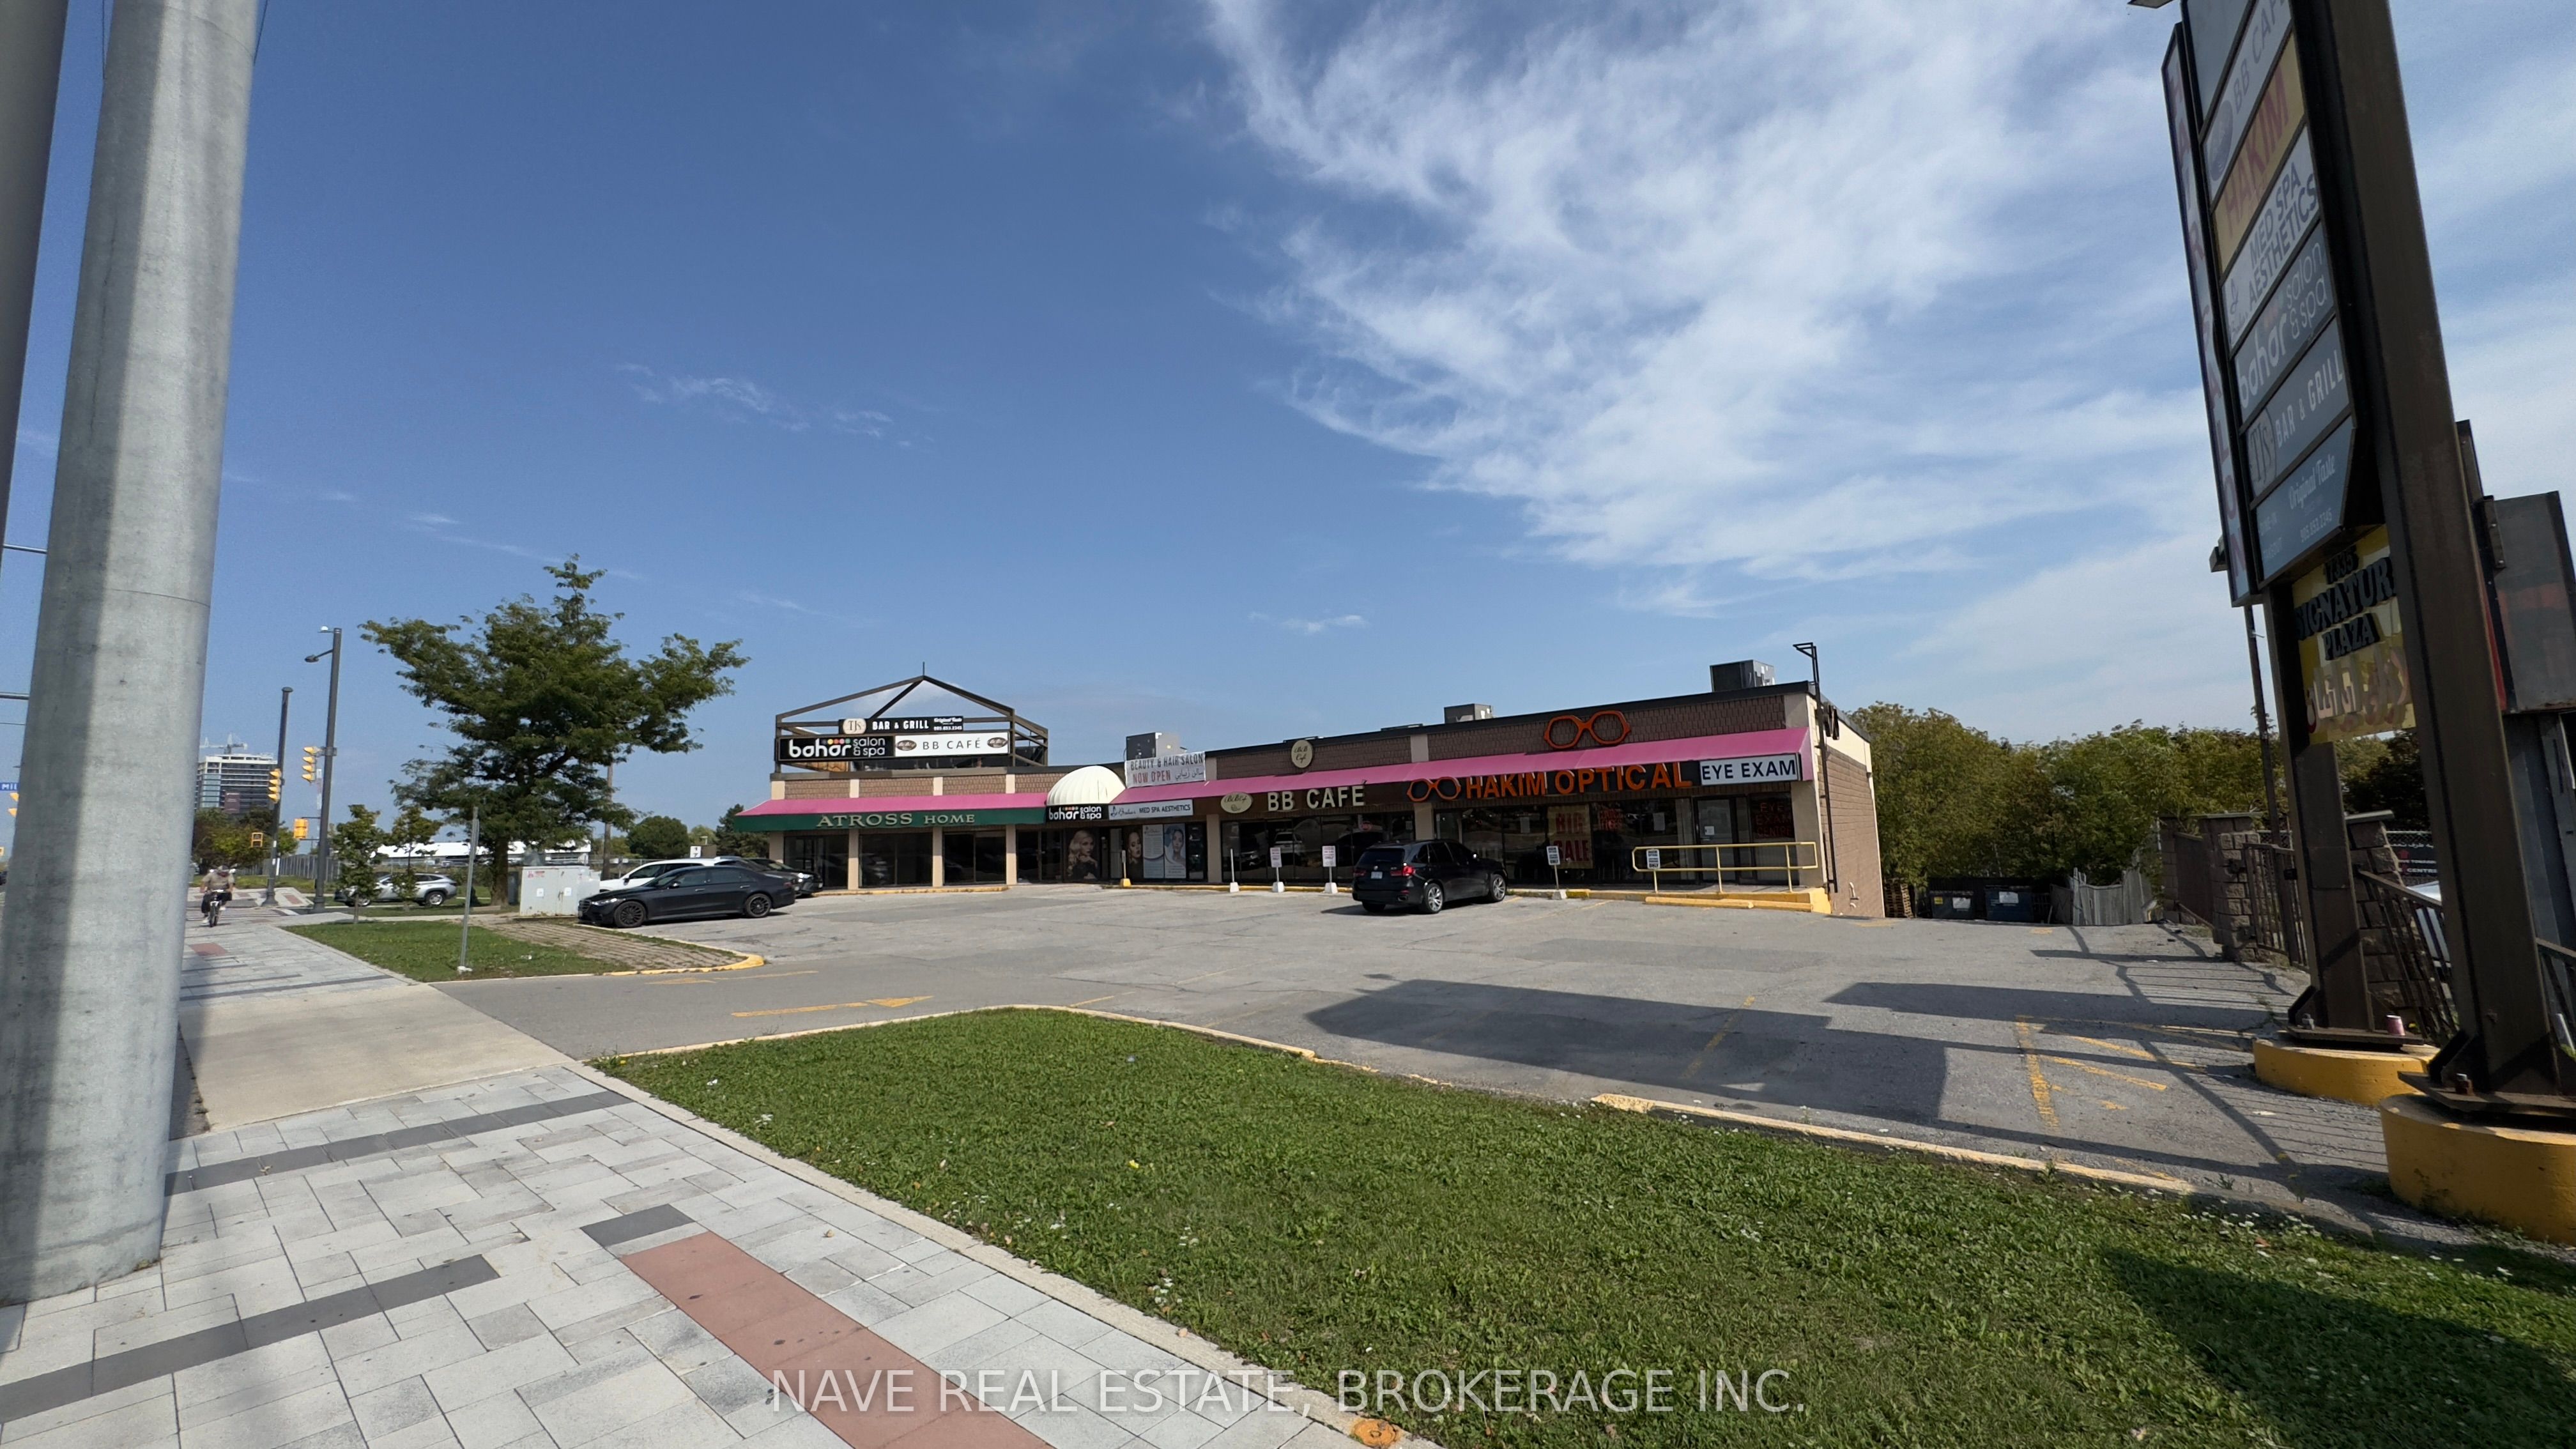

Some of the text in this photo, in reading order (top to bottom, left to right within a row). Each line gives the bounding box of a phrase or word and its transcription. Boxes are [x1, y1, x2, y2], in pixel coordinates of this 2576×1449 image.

[2233, 0, 2285, 114] BB CAF
[2225, 62, 2288, 236] HAKIM
[2250, 208, 2274, 270] MED
[2276, 162, 2301, 222] SPA
[2248, 172, 2317, 312] AESTHETICS
[2287, 242, 2322, 309] salon
[2300, 274, 2327, 328] spa
[2237, 312, 2287, 409] bahar
[2276, 404, 2296, 448] BAR
[2299, 398, 2306, 421] &
[2307, 349, 2343, 411] GRILL
[2294, 557, 2396, 640] SIGNATUR
[2322, 614, 2377, 660] PLAZA
[872, 721, 890, 730] BAR
[903, 720, 929, 729] GRILL
[789, 738, 852, 758] bahar
[853, 737, 885, 746] salon
[923, 741, 939, 750] BB
[947, 738, 981, 749] CAFÉ
[854, 746, 885, 758] & spa
[1131, 760, 1154, 770] BEAUTY
[1163, 756, 1179, 767] HAIR
[1181, 753, 1204, 765] SALON
[1133, 770, 1171, 783] NOW OPEN
[1702, 760, 1796, 780] EYE EXAM
[1466, 762, 1692, 799] HAKIM OPTICAL
[1080, 805, 1101, 813] salon
[1268, 791, 1294, 811] BB
[1760, 801, 1784, 812] EYE
[816, 813, 975, 827] ATROSS HOME
[1048, 806, 1080, 820] bahar
[1085, 813, 1101, 821] spa
[1555, 812, 1583, 834] BIG
[1553, 839, 1589, 862] SALE
